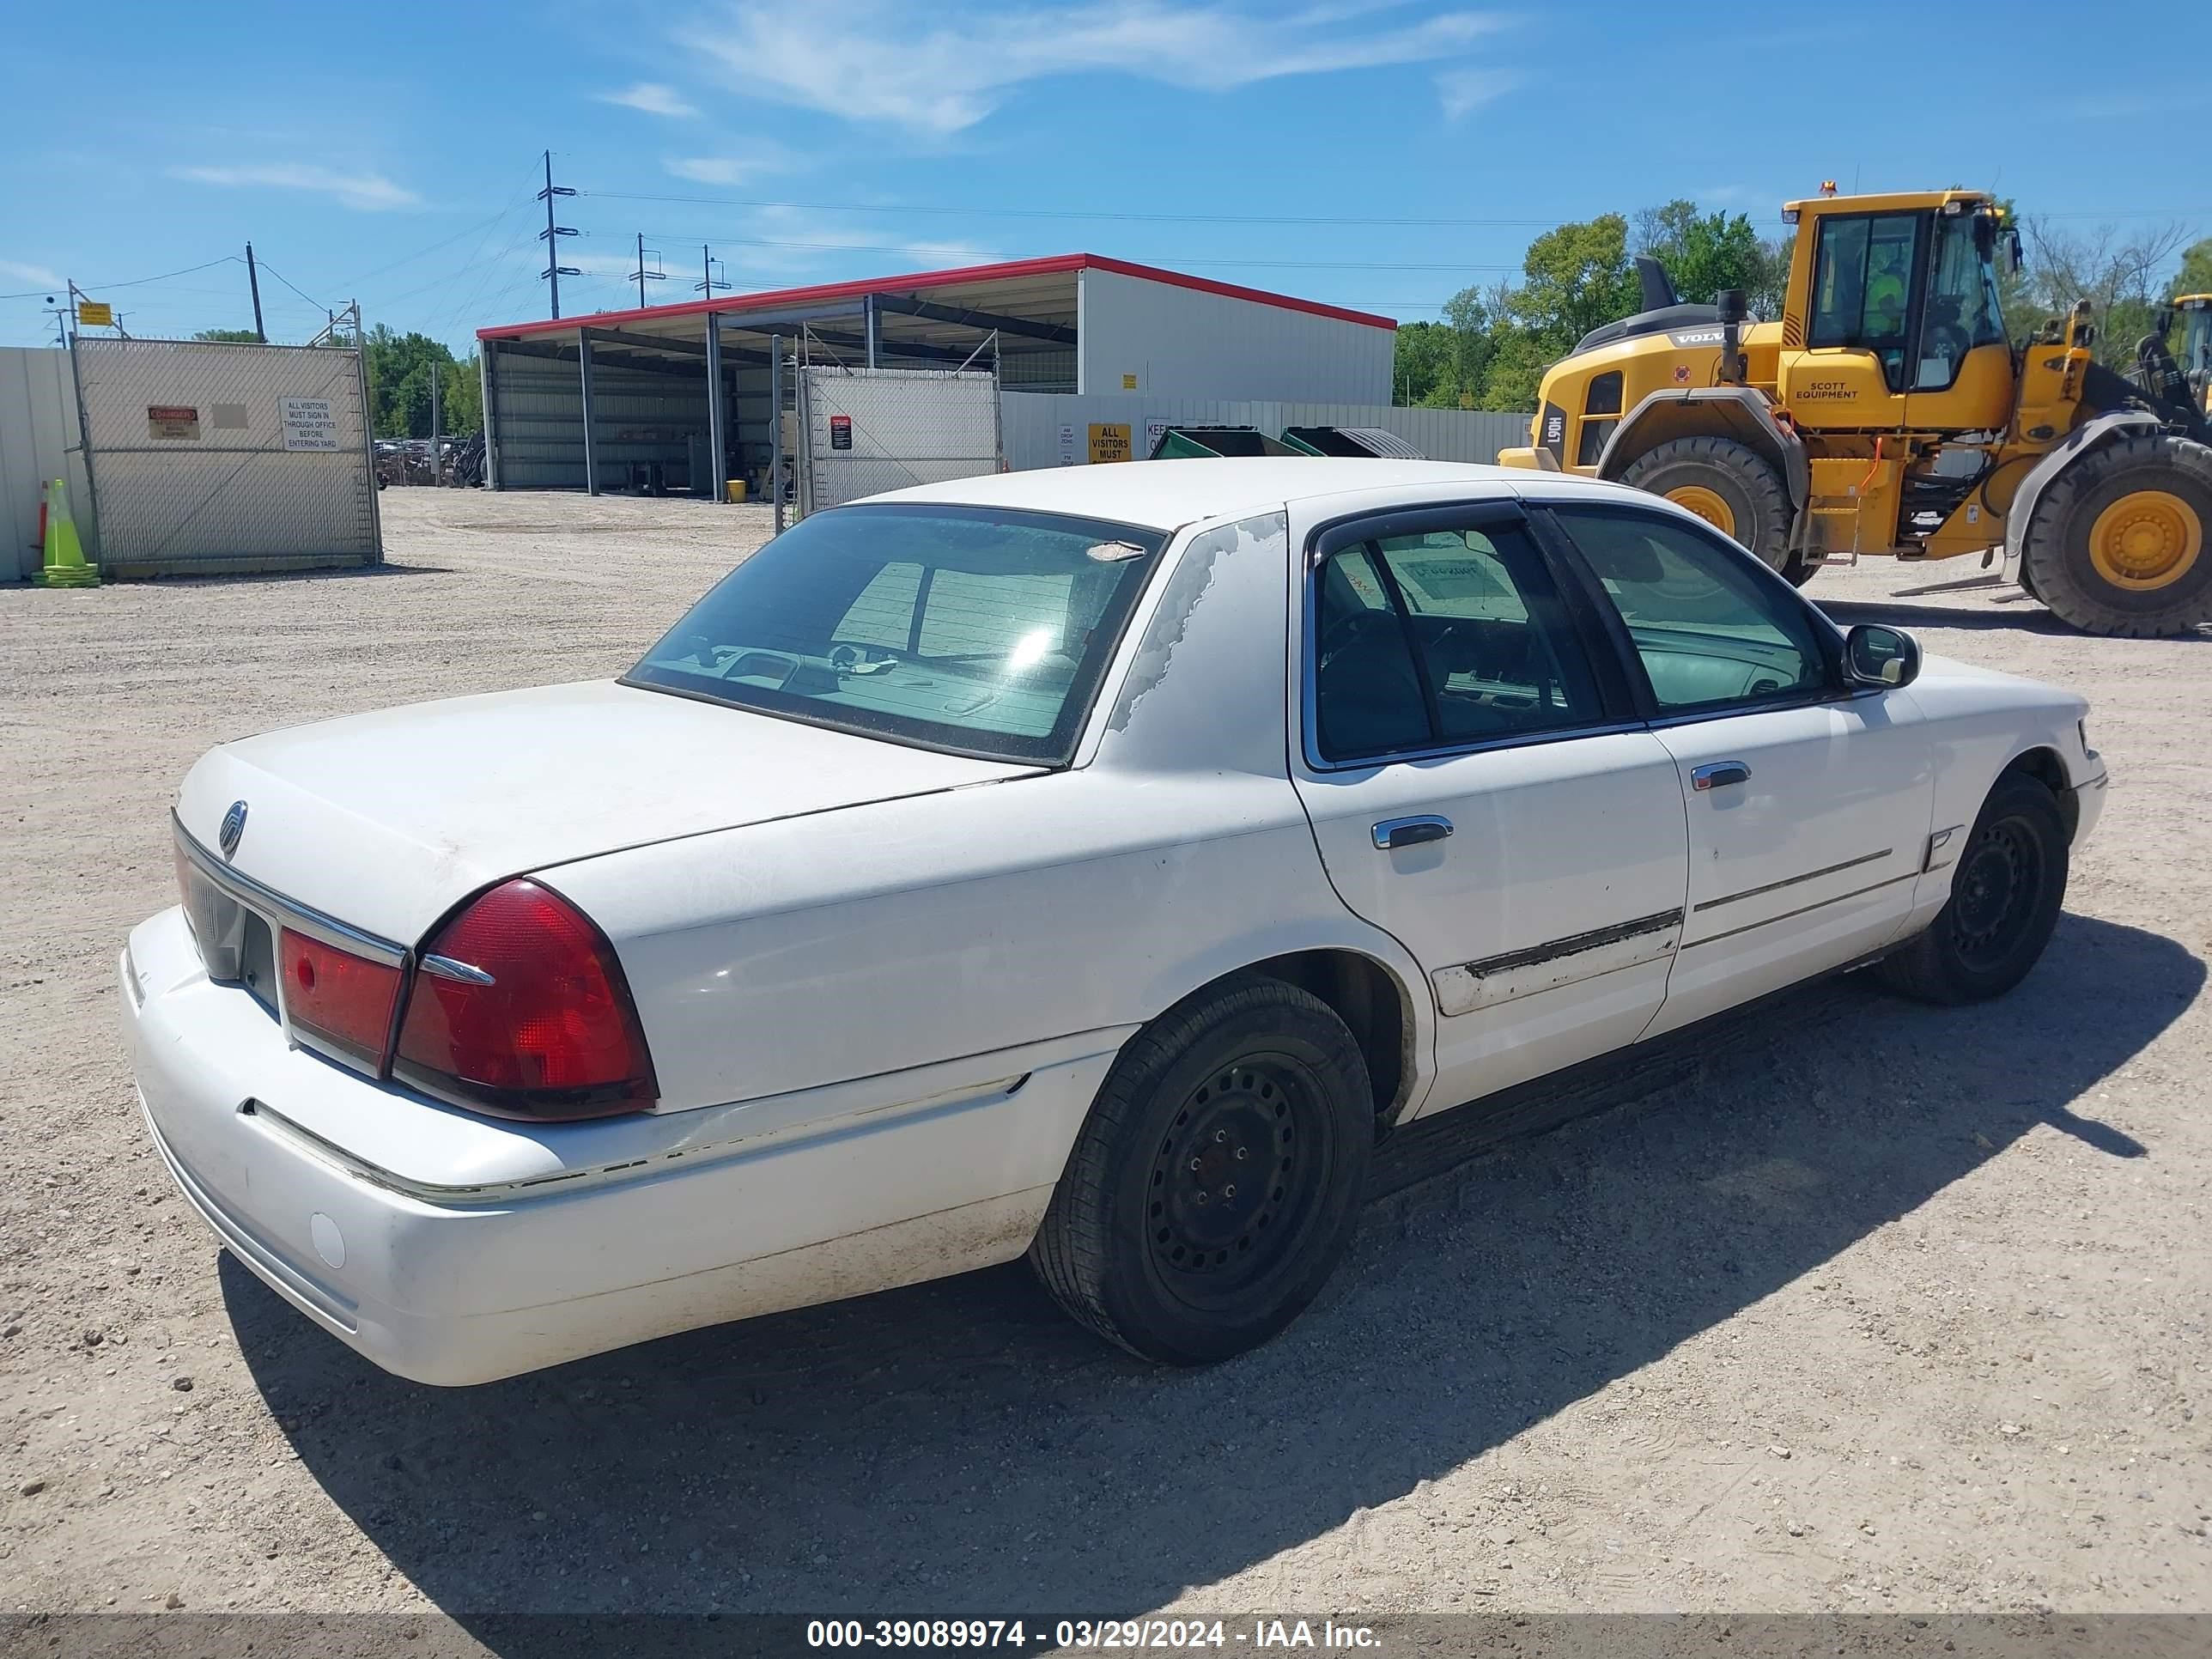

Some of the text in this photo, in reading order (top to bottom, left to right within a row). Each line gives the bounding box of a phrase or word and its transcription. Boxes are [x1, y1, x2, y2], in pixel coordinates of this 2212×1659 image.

[1677, 332, 1723, 343] VOLV
[1796, 391, 1858, 399] EQUIPMENT
[1102, 427, 1119, 437] ALL
[1147, 424, 1166, 435] KEE
[1547, 416, 1562, 443] L90H
[1092, 439, 1128, 448] VISITORS
[1099, 450, 1121, 459] MUST
